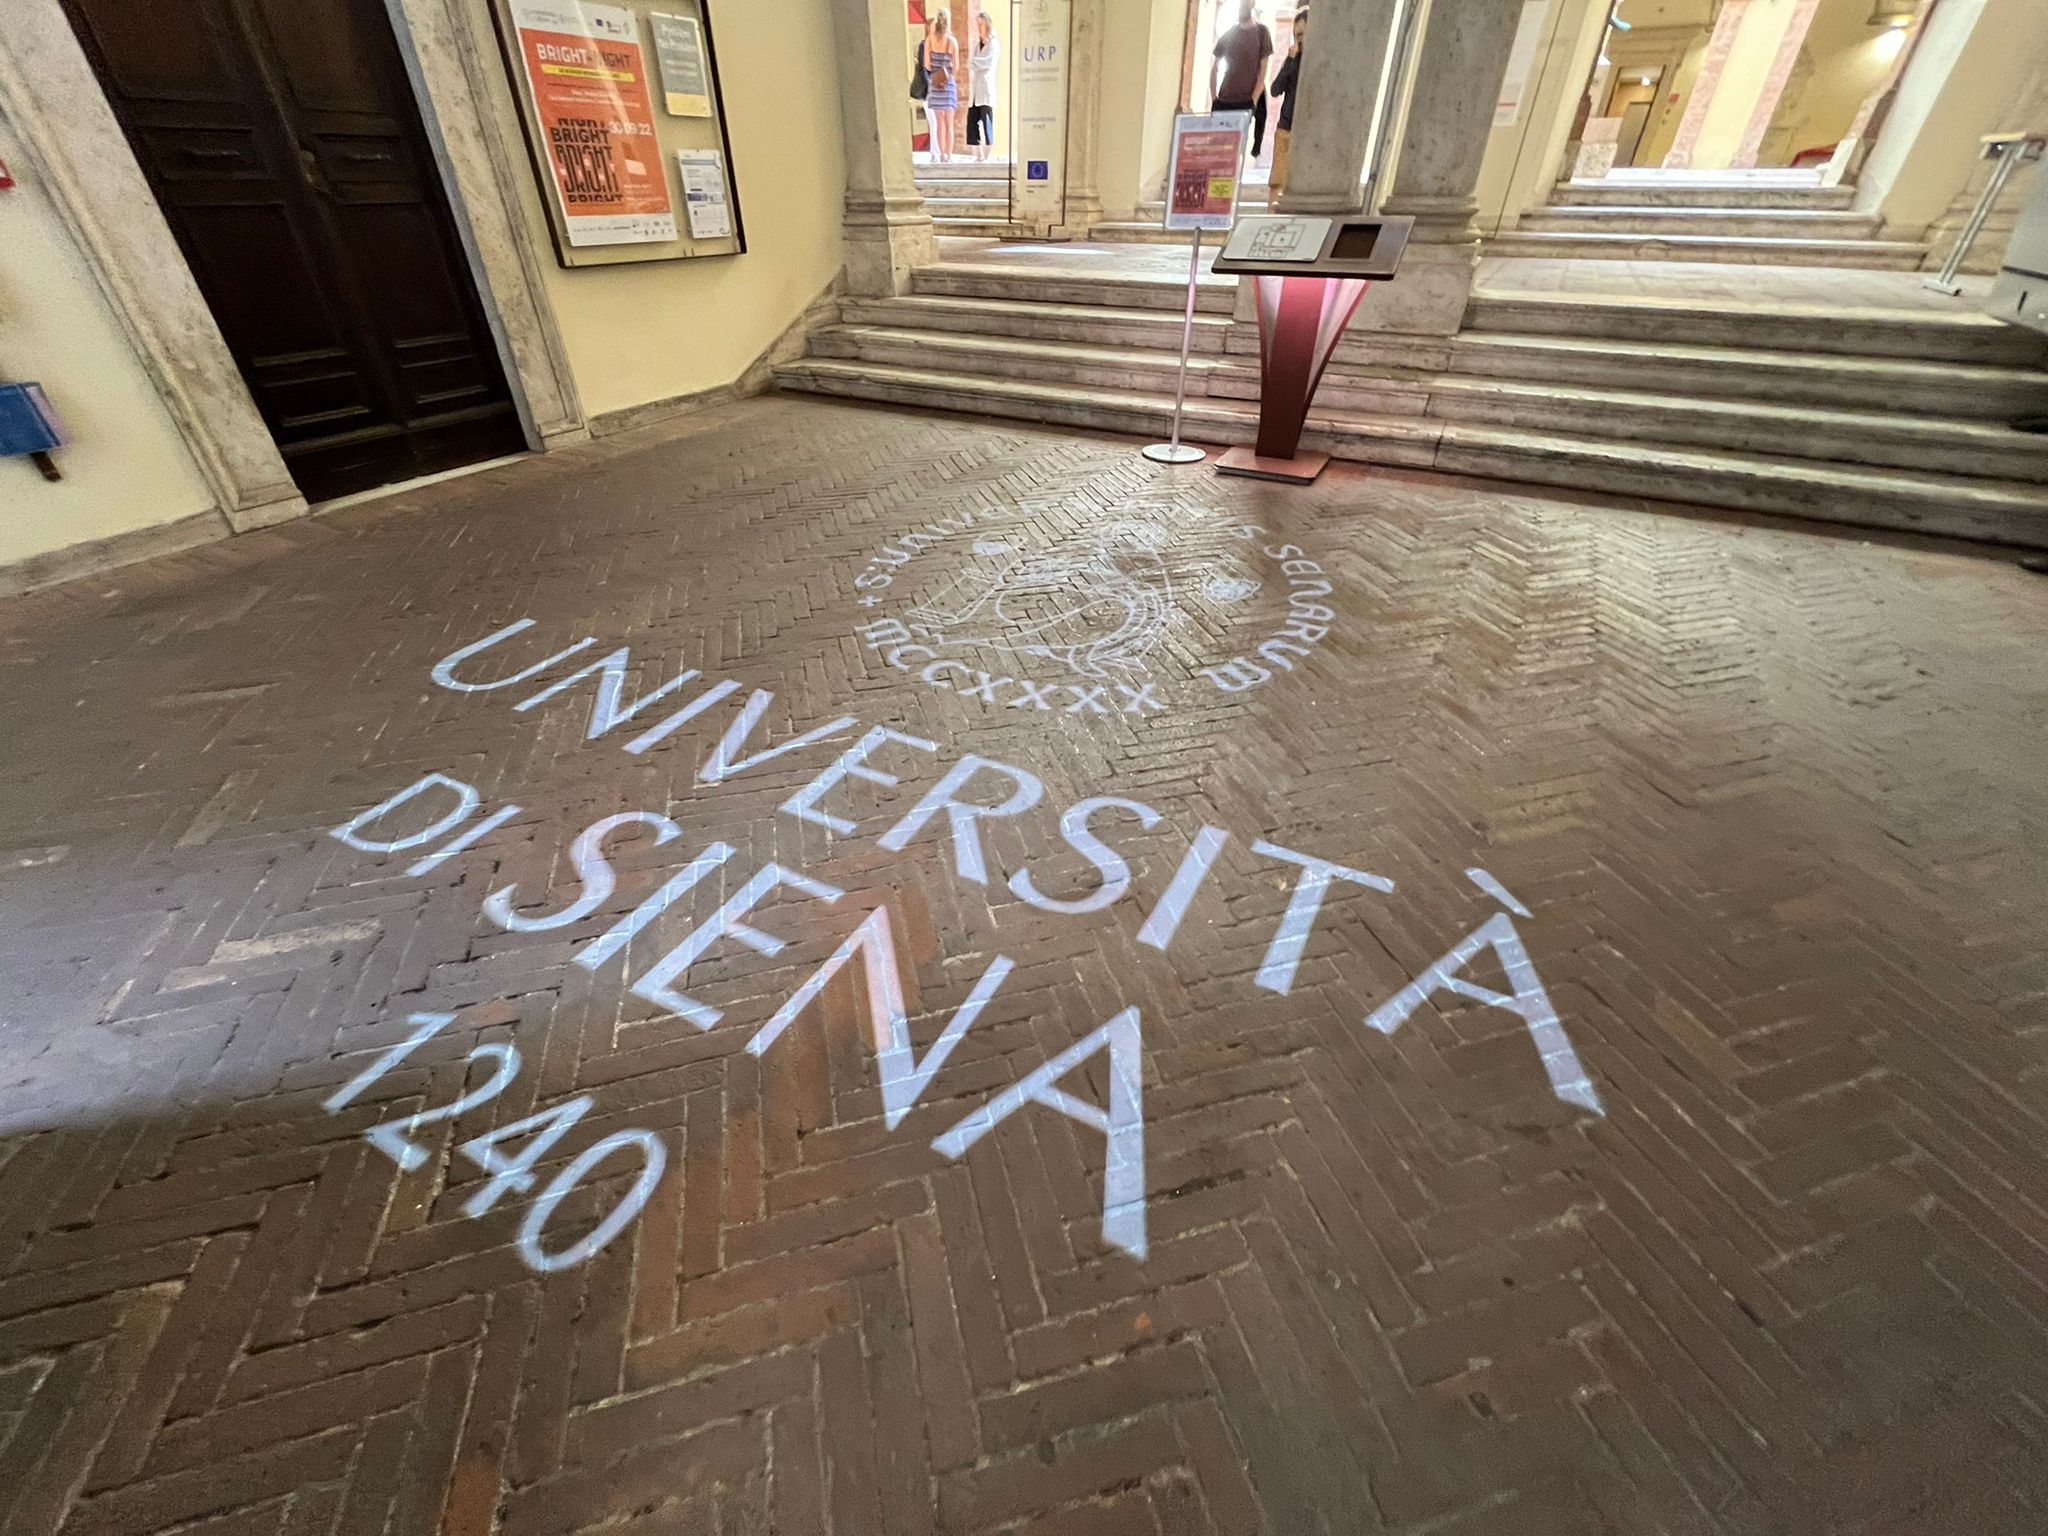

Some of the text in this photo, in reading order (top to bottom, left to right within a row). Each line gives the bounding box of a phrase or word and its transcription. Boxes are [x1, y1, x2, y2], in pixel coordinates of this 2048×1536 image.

[536, 43, 631, 68] BRIGHT-IGHT
[1024, 46, 1056, 62] URP
[551, 128, 610, 144] BRIGHT
[328, 772, 525, 877] DI
[430, 617, 1604, 1117] UNIVERSITÀ
[481, 810, 1149, 1261] SIENA
[321, 1011, 667, 1272] 1240
